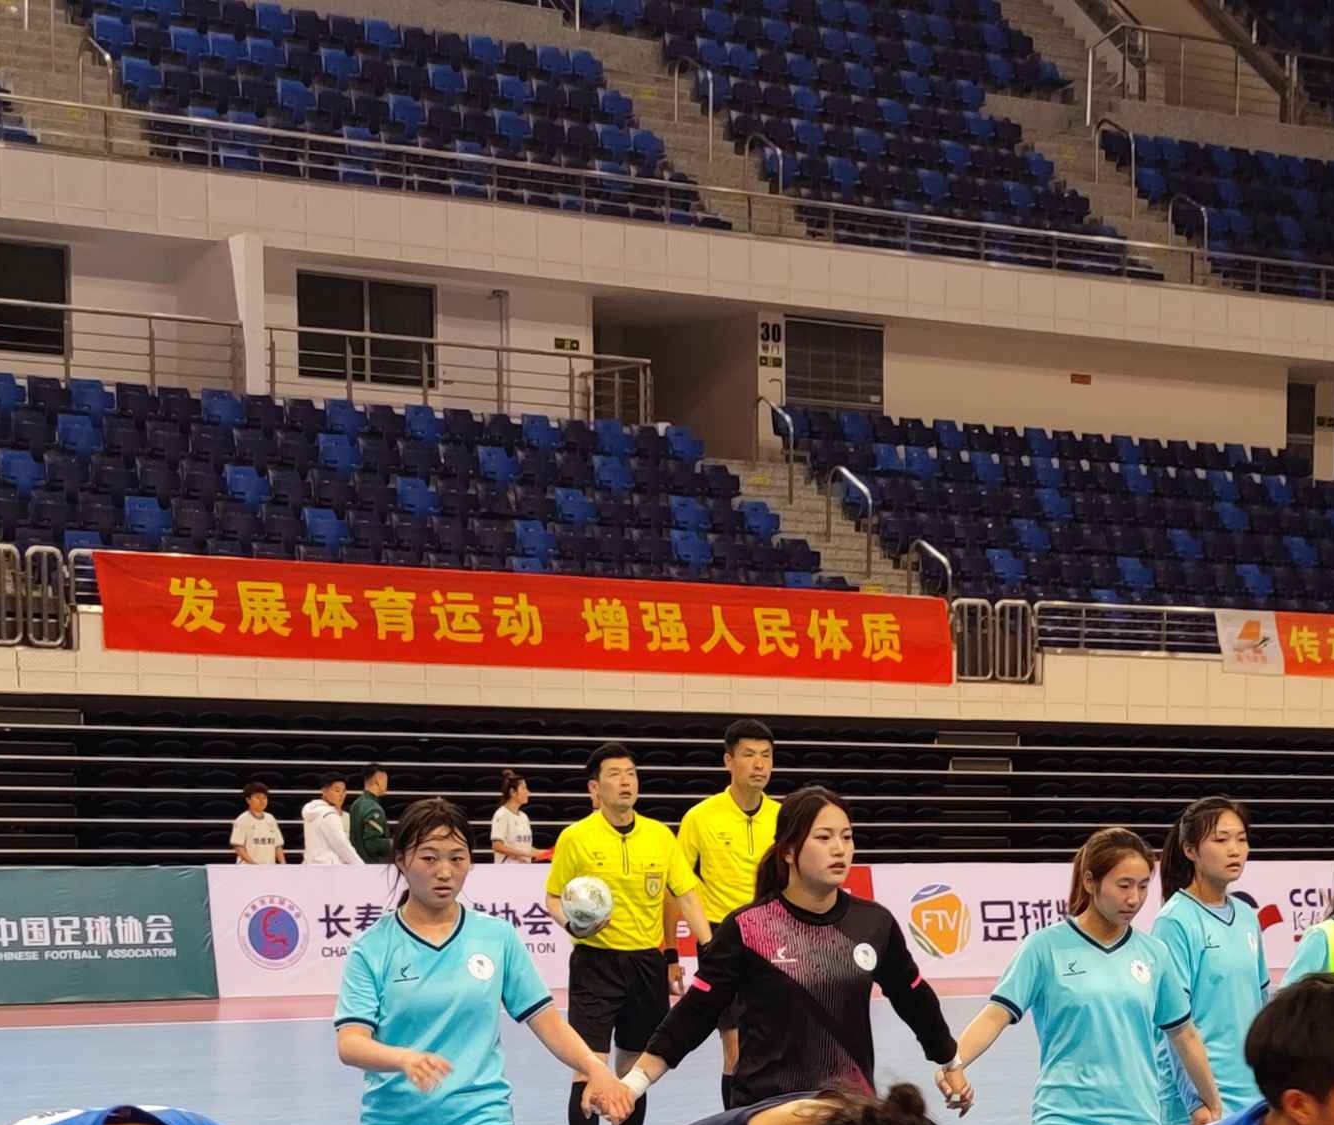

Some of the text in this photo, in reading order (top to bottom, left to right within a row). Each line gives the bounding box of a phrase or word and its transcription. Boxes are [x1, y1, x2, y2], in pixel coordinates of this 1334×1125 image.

[760, 321, 781, 343] 30
[169, 577, 905, 664] 发展体育运动 增强人民体质
[920, 909, 959, 932] FTV
[45, 949, 102, 961] FOOTBALL
[106, 947, 177, 960] ASSOCIATION
